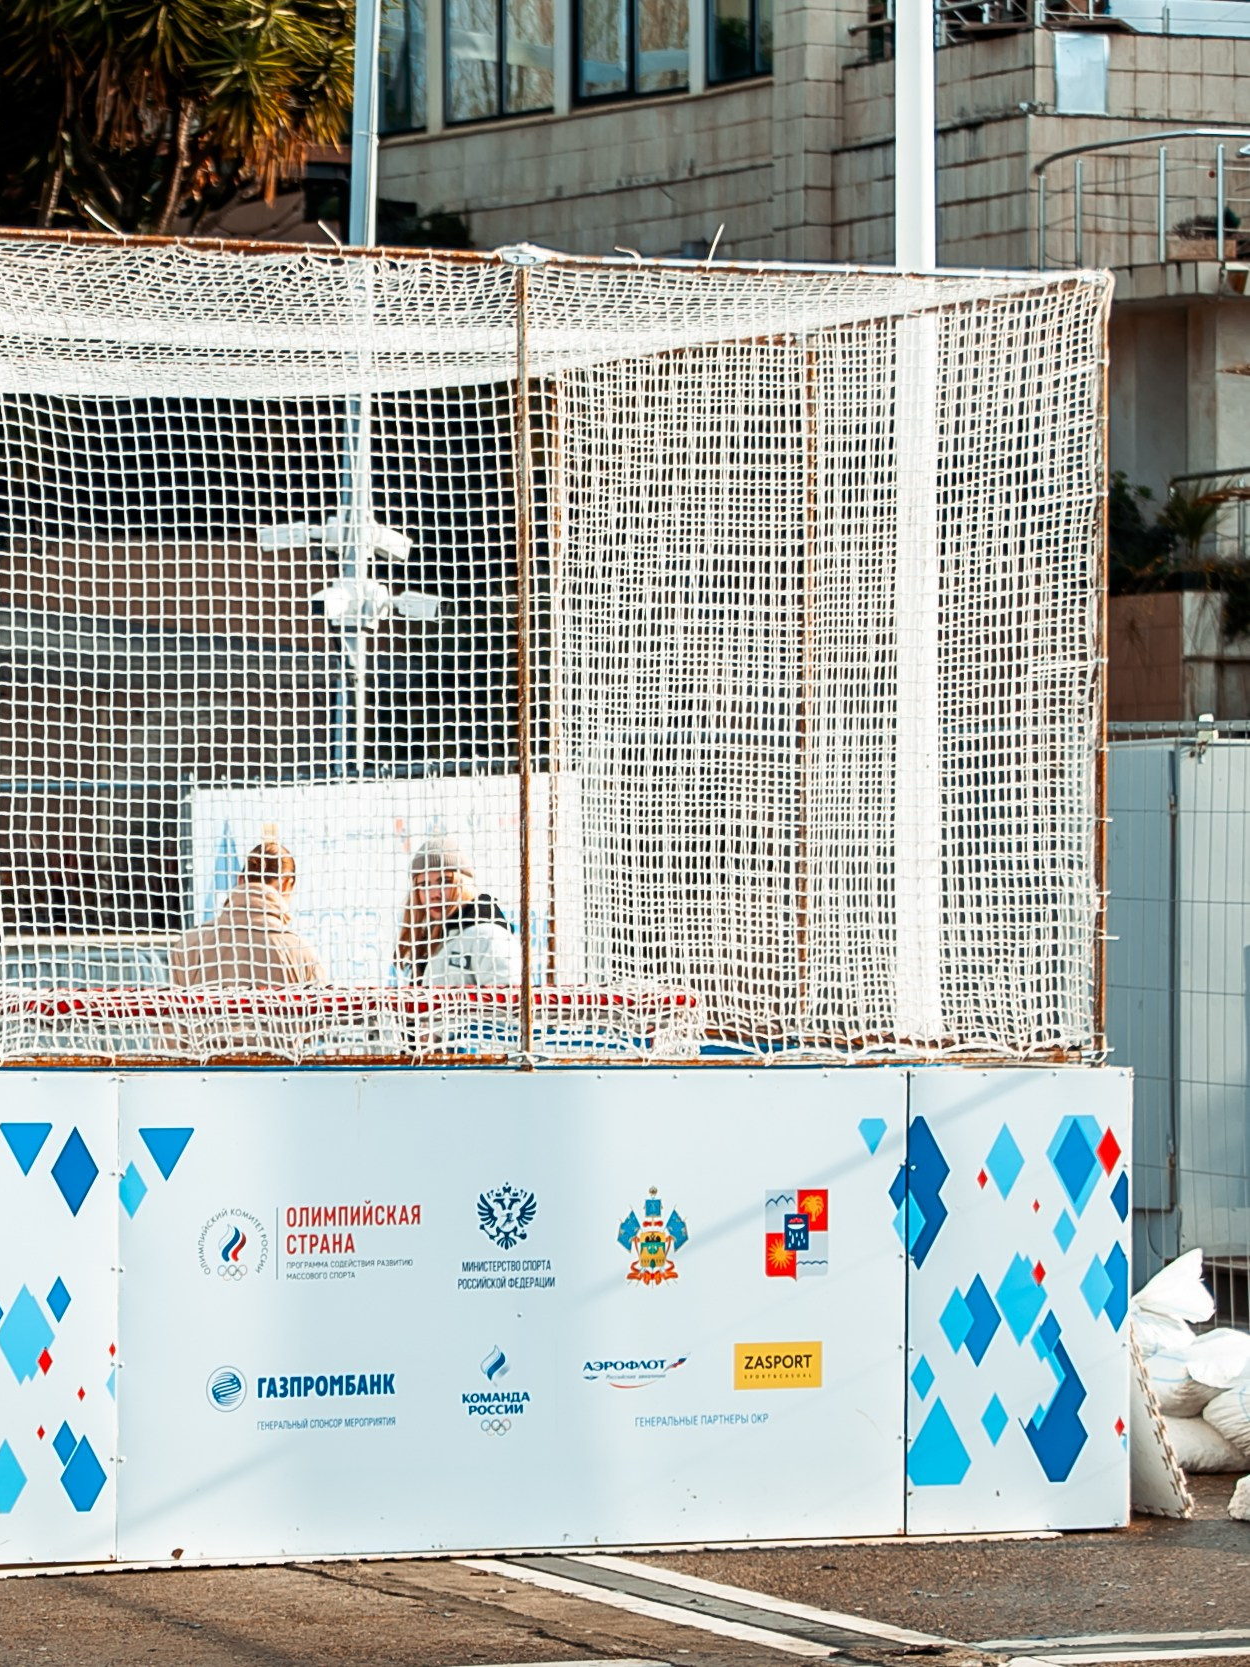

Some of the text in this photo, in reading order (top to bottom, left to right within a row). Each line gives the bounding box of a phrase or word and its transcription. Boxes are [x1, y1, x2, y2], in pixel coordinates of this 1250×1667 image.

[286, 1200, 421, 1228] ОЛИМПИЙСКАЯ
[197, 1207, 269, 1276] ОЛИМПИЙСКИЙ КОМИТЕТ РОССИИ
[286, 1233, 356, 1255] СТРАНА
[286, 1259, 413, 1270] ПРОГРАММА СОДЕЙСТВИЯ РАЗВИТИЮ
[461, 1259, 552, 1272] МИНИСТЕРСТВО СПОРТА
[286, 1272, 356, 1281] МАССОВОГО СПОРТА
[457, 1276, 556, 1290] РОССИЙСКОЙ ФЕДЕРАЦИИ
[582, 1360, 667, 1372] АЭРОФЛОТ
[744, 1354, 813, 1370] ZASPORT
[257, 1373, 396, 1399] ГАЗПРОМБАНК
[461, 1391, 530, 1404] КОМАНДА
[468, 1404, 524, 1416] РОССИИ
[257, 1416, 396, 1431] ГЕНЕРАЛЬНЫЙ СПОНСОР МЕРОПРИЯТИЯ
[635, 1413, 769, 1427] ГЕНЕРАЛЬНЫЕ ПАРТНЕРЫ ОКР
